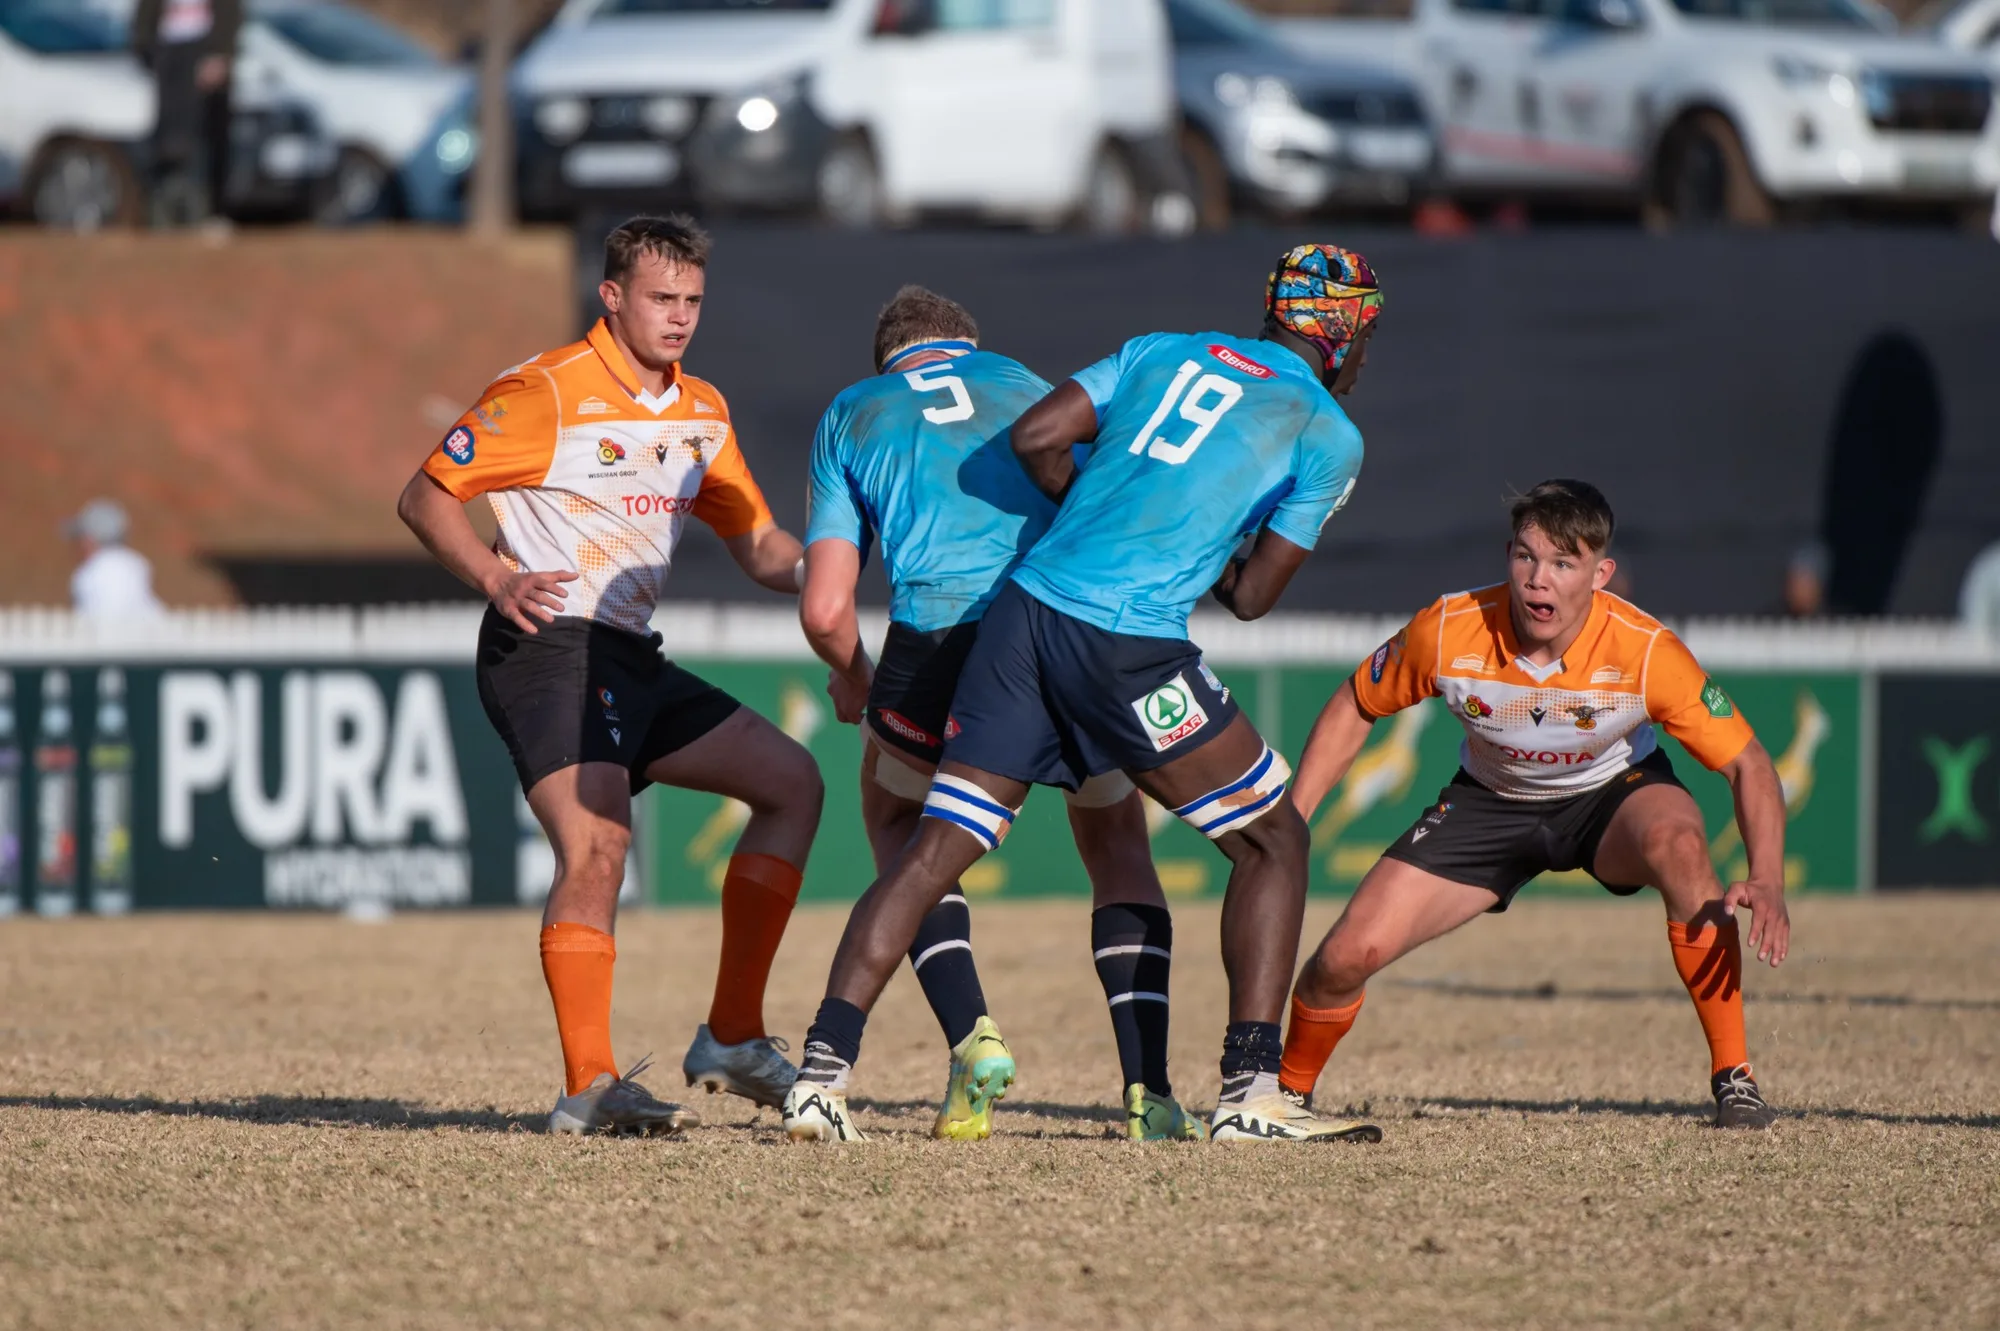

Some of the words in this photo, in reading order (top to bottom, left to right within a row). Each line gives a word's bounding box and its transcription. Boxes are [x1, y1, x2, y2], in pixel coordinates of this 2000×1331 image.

[1217, 349, 1266, 376] OBARO
[903, 363, 974, 425] 5
[1129, 360, 1243, 465] 19
[588, 471, 618, 480] WISEMAN
[886, 712, 927, 743] OBARO
[1160, 715, 1202, 746] SPAR
[1482, 724, 1504, 733] GROUP
[159, 671, 469, 849] PURA
[1486, 741, 1595, 765] OYOTA
